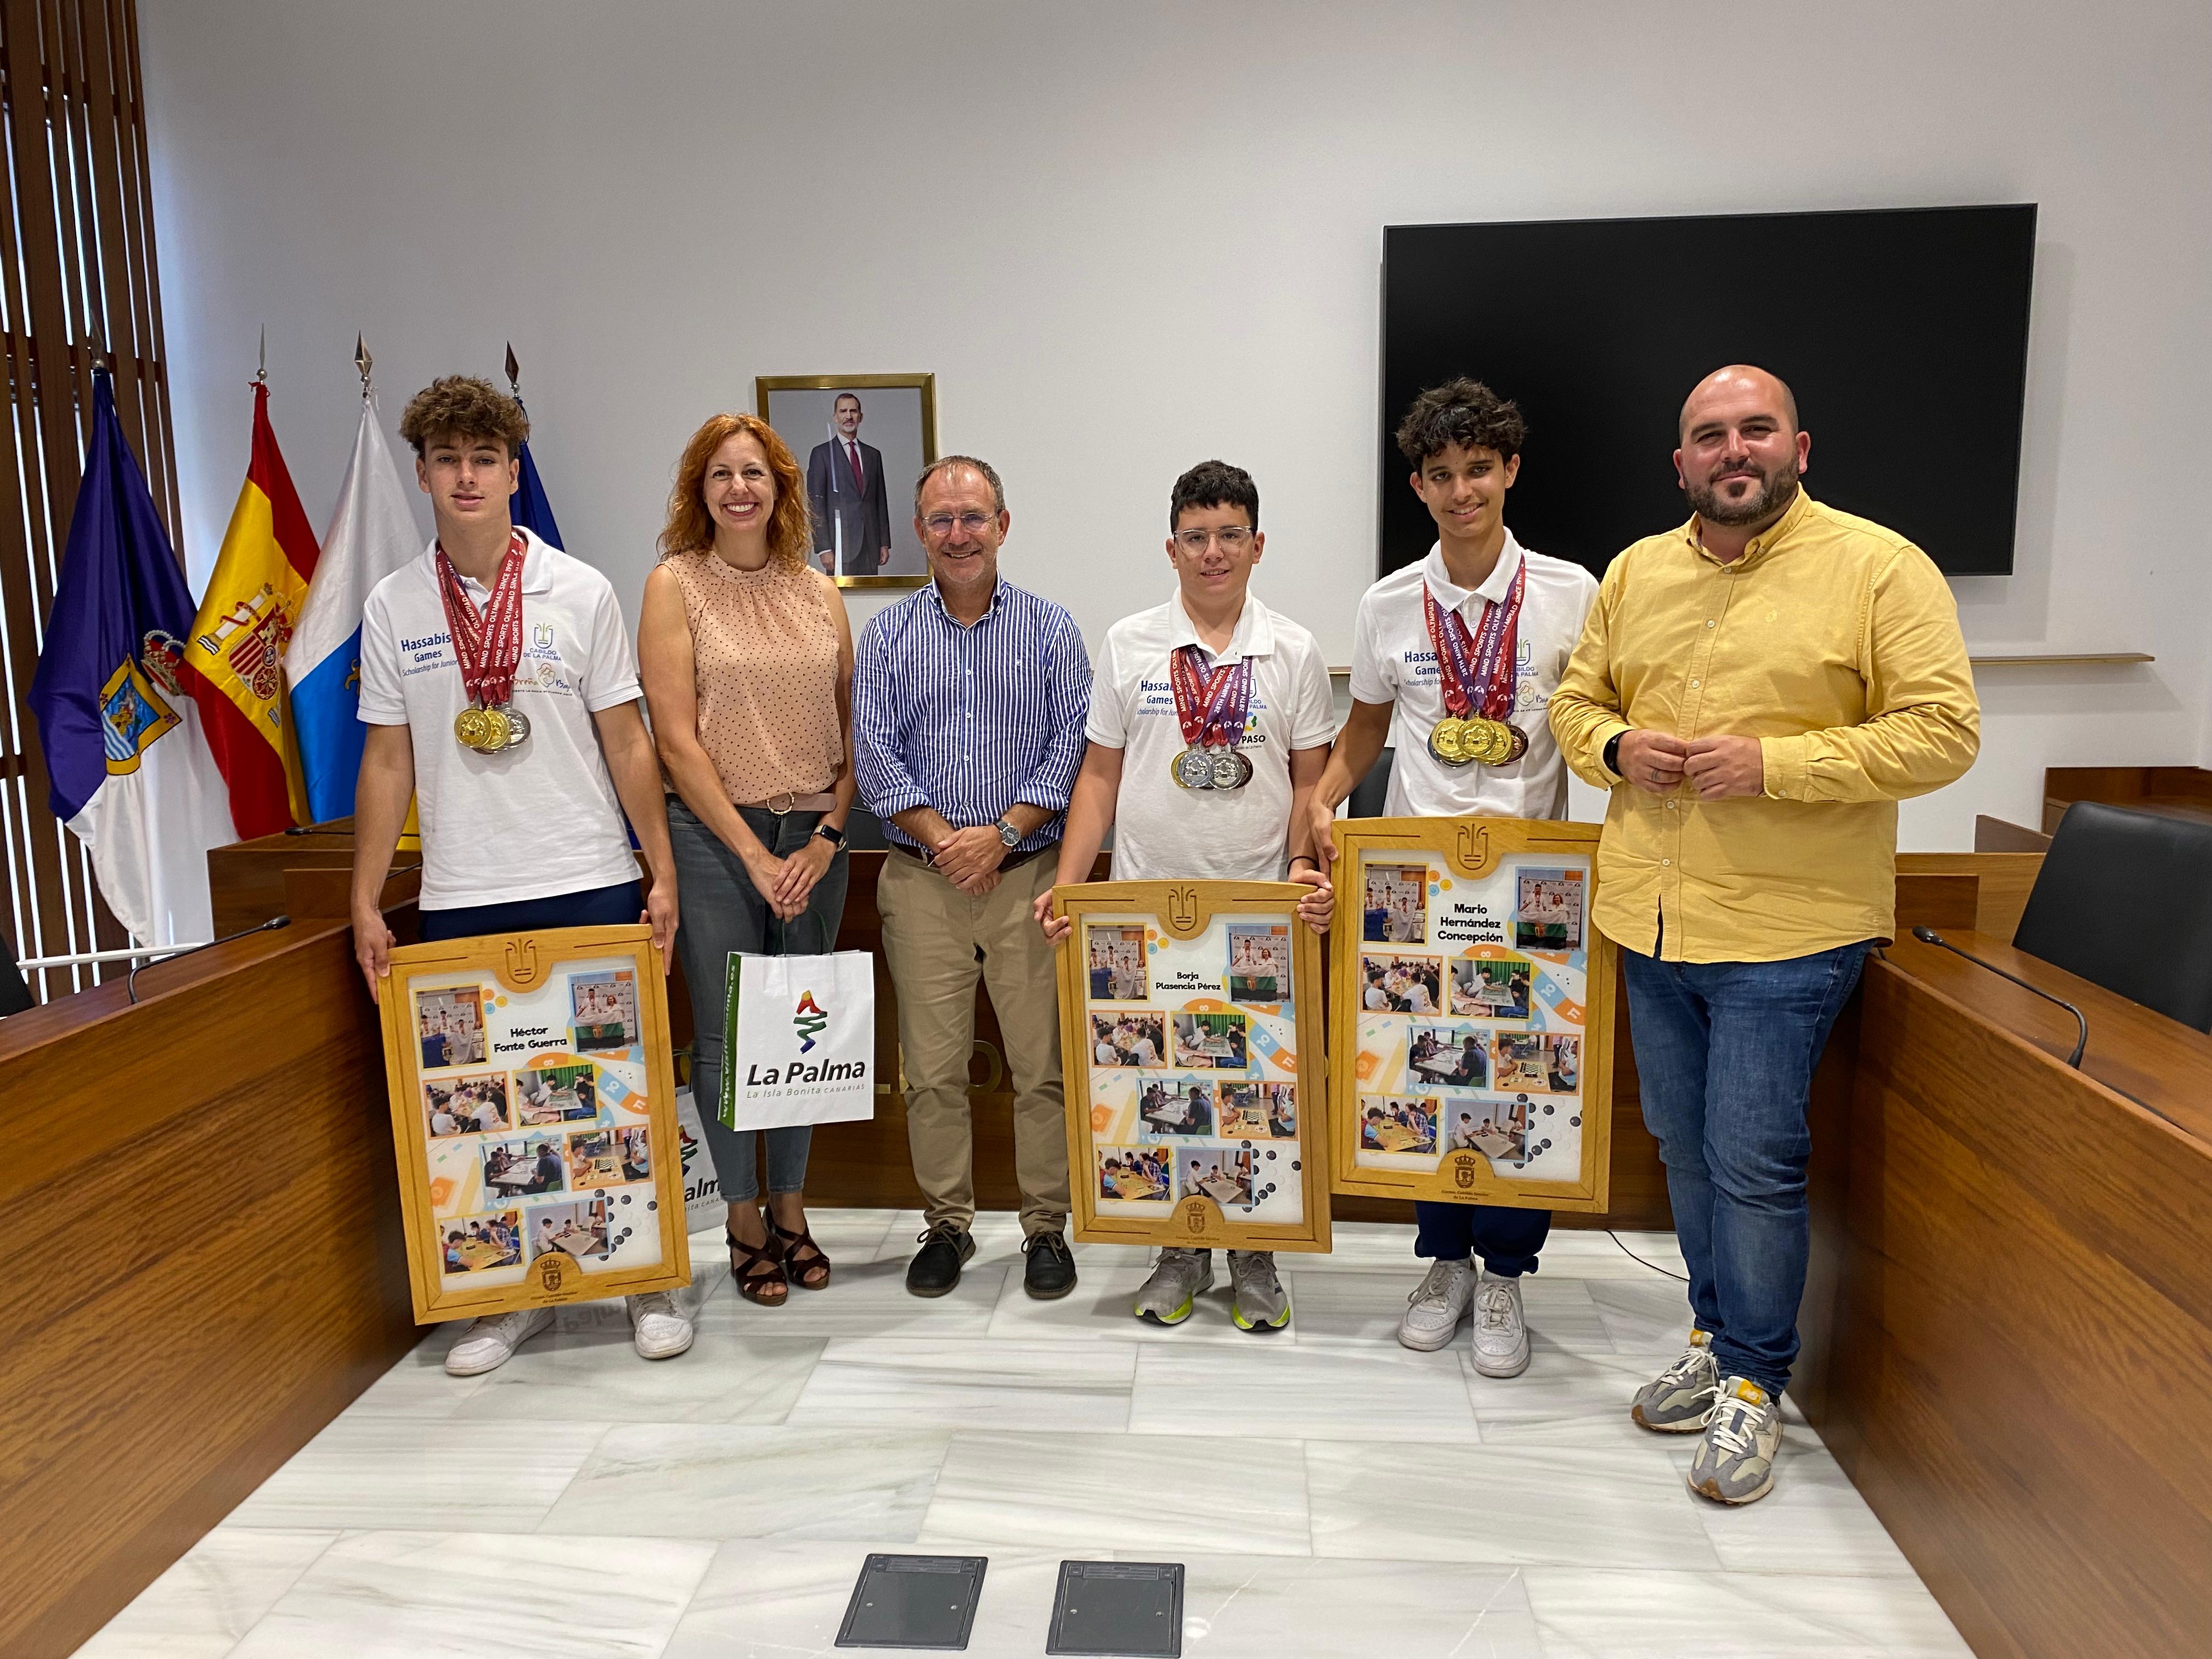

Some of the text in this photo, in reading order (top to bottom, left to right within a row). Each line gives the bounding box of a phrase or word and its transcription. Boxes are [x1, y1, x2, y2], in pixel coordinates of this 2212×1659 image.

[462, 596, 480, 629] OLYMPIAD
[479, 650, 488, 668] MIND
[484, 624, 494, 648] SPORTS
[489, 591, 503, 623] OLYMPIAD
[499, 573, 510, 590] SINCE
[498, 623, 509, 648] SPORTS
[504, 591, 516, 623] OLYMPIAD
[1427, 602, 1436, 633] OLYMPIAD
[1444, 617, 1457, 641] SPORTS
[400, 633, 452, 651] Hassabis
[1474, 631, 1487, 657] SPORTS
[415, 650, 442, 662] Games
[1404, 651, 1437, 663] Hassa
[1440, 639, 1448, 664] SPORTS
[1453, 642, 1462, 660] MIND
[1481, 658, 1489, 676] MIND
[1485, 632, 1497, 657] SPORTS
[402, 664, 431, 676] Scholarship
[441, 659, 459, 668] Junior
[461, 652, 471, 669] MIND
[1191, 647, 1206, 673] OLYMPIAD
[1493, 657, 1501, 674] MIND
[1415, 666, 1441, 675] Game
[1445, 665, 1454, 682] MIND
[1458, 661, 1468, 677] 28TH
[1141, 680, 1173, 691] Hassa
[1173, 670, 1182, 693] SPORTS
[1203, 691, 1214, 708] MIND
[1210, 669, 1226, 691] SPORTS
[1147, 695, 1173, 704] Games
[1178, 695, 1186, 712] MIND
[1214, 698, 1224, 713] 28TH
[1221, 683, 1231, 698] MIND
[1242, 735, 1266, 743] PASO
[1454, 904, 1487, 914] Mario
[1441, 917, 1500, 928] Hernández
[1437, 930, 1503, 944] Concepción
[1177, 972, 1199, 981] Borja
[1541, 984, 1556, 997] 10
[510, 1026, 548, 1037] Héctor
[494, 1039, 567, 1052] Fonte Guerra
[1256, 1034, 1270, 1047] 10
[747, 1059, 865, 1086] La Palma
[606, 1081, 620, 1093] 10
[764, 1089, 781, 1097] Isla
[787, 1087, 821, 1096] Bonita
[824, 1084, 865, 1093] CANARIAS
[684, 1177, 720, 1203] alm
[702, 1198, 719, 1207] CANA
